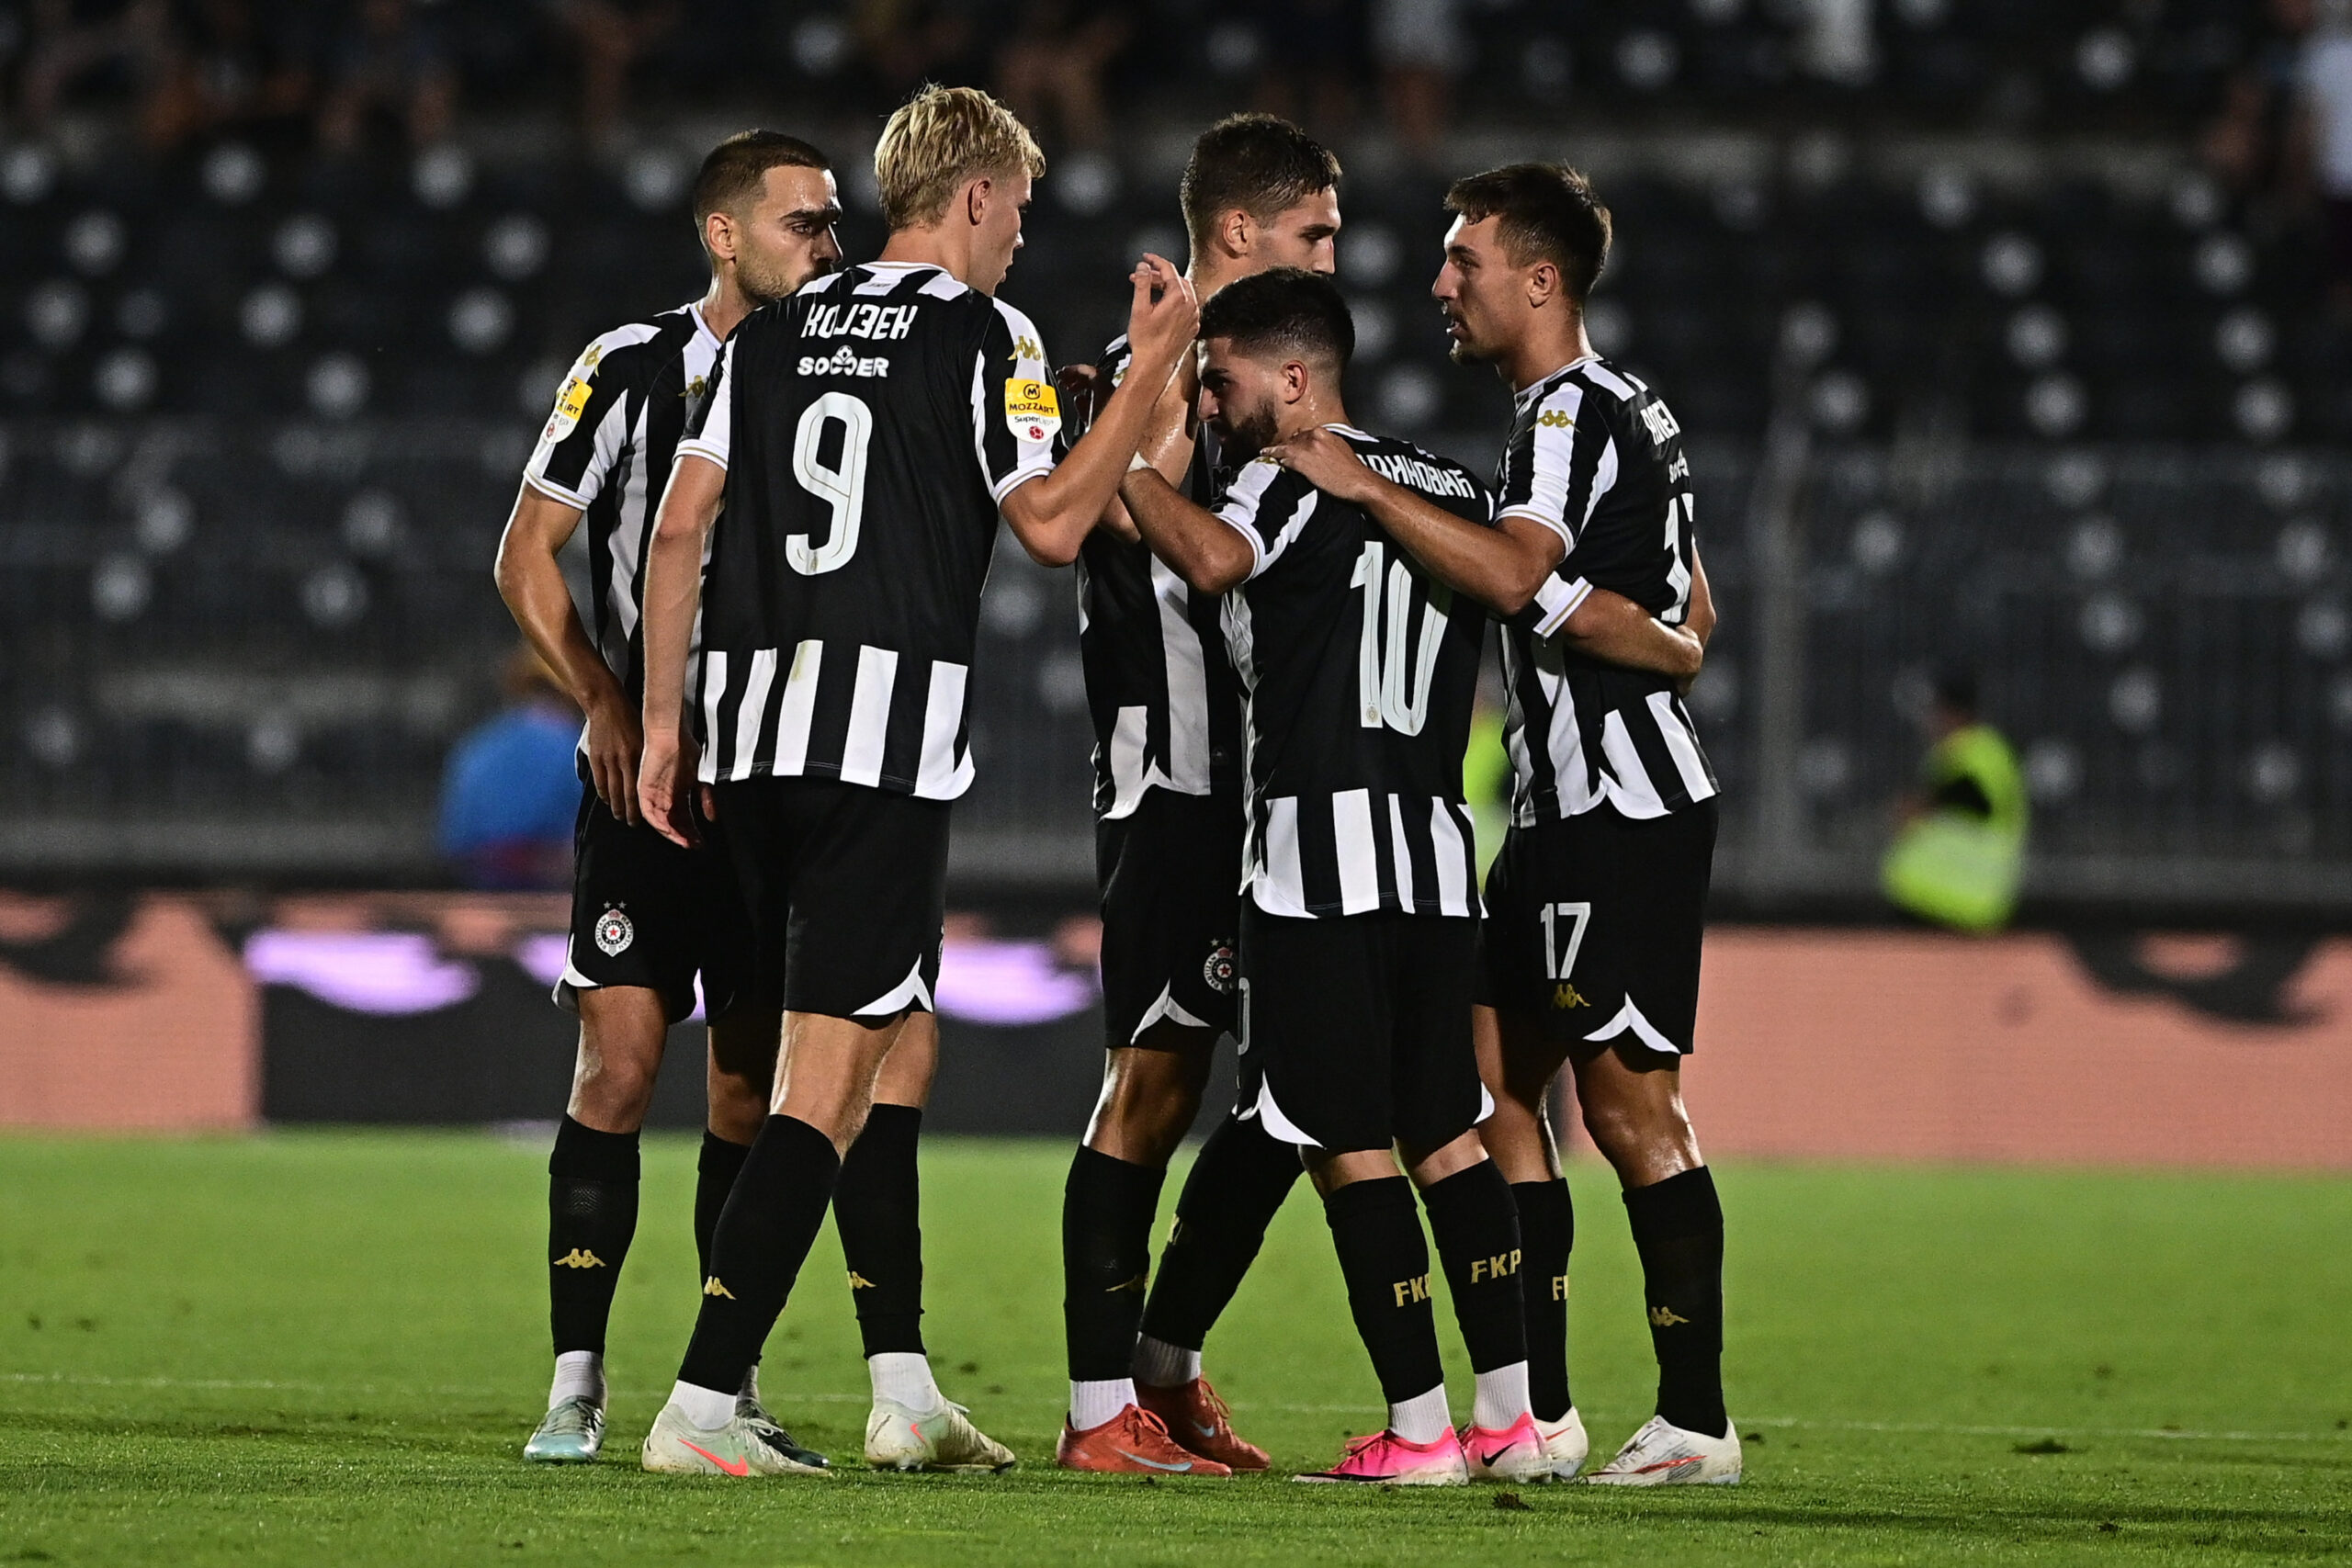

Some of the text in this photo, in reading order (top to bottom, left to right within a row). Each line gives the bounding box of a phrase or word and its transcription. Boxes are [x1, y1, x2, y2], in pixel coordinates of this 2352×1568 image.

[797, 345, 889, 378] SOCCER
[1009, 402, 1055, 413] MOZZART
[786, 391, 872, 575] 9
[1355, 454, 1476, 499] ДИНОВИЋ
[1350, 540, 1449, 737] 10
[1540, 902, 1591, 979] 17
[1470, 1248, 1521, 1284] FKP
